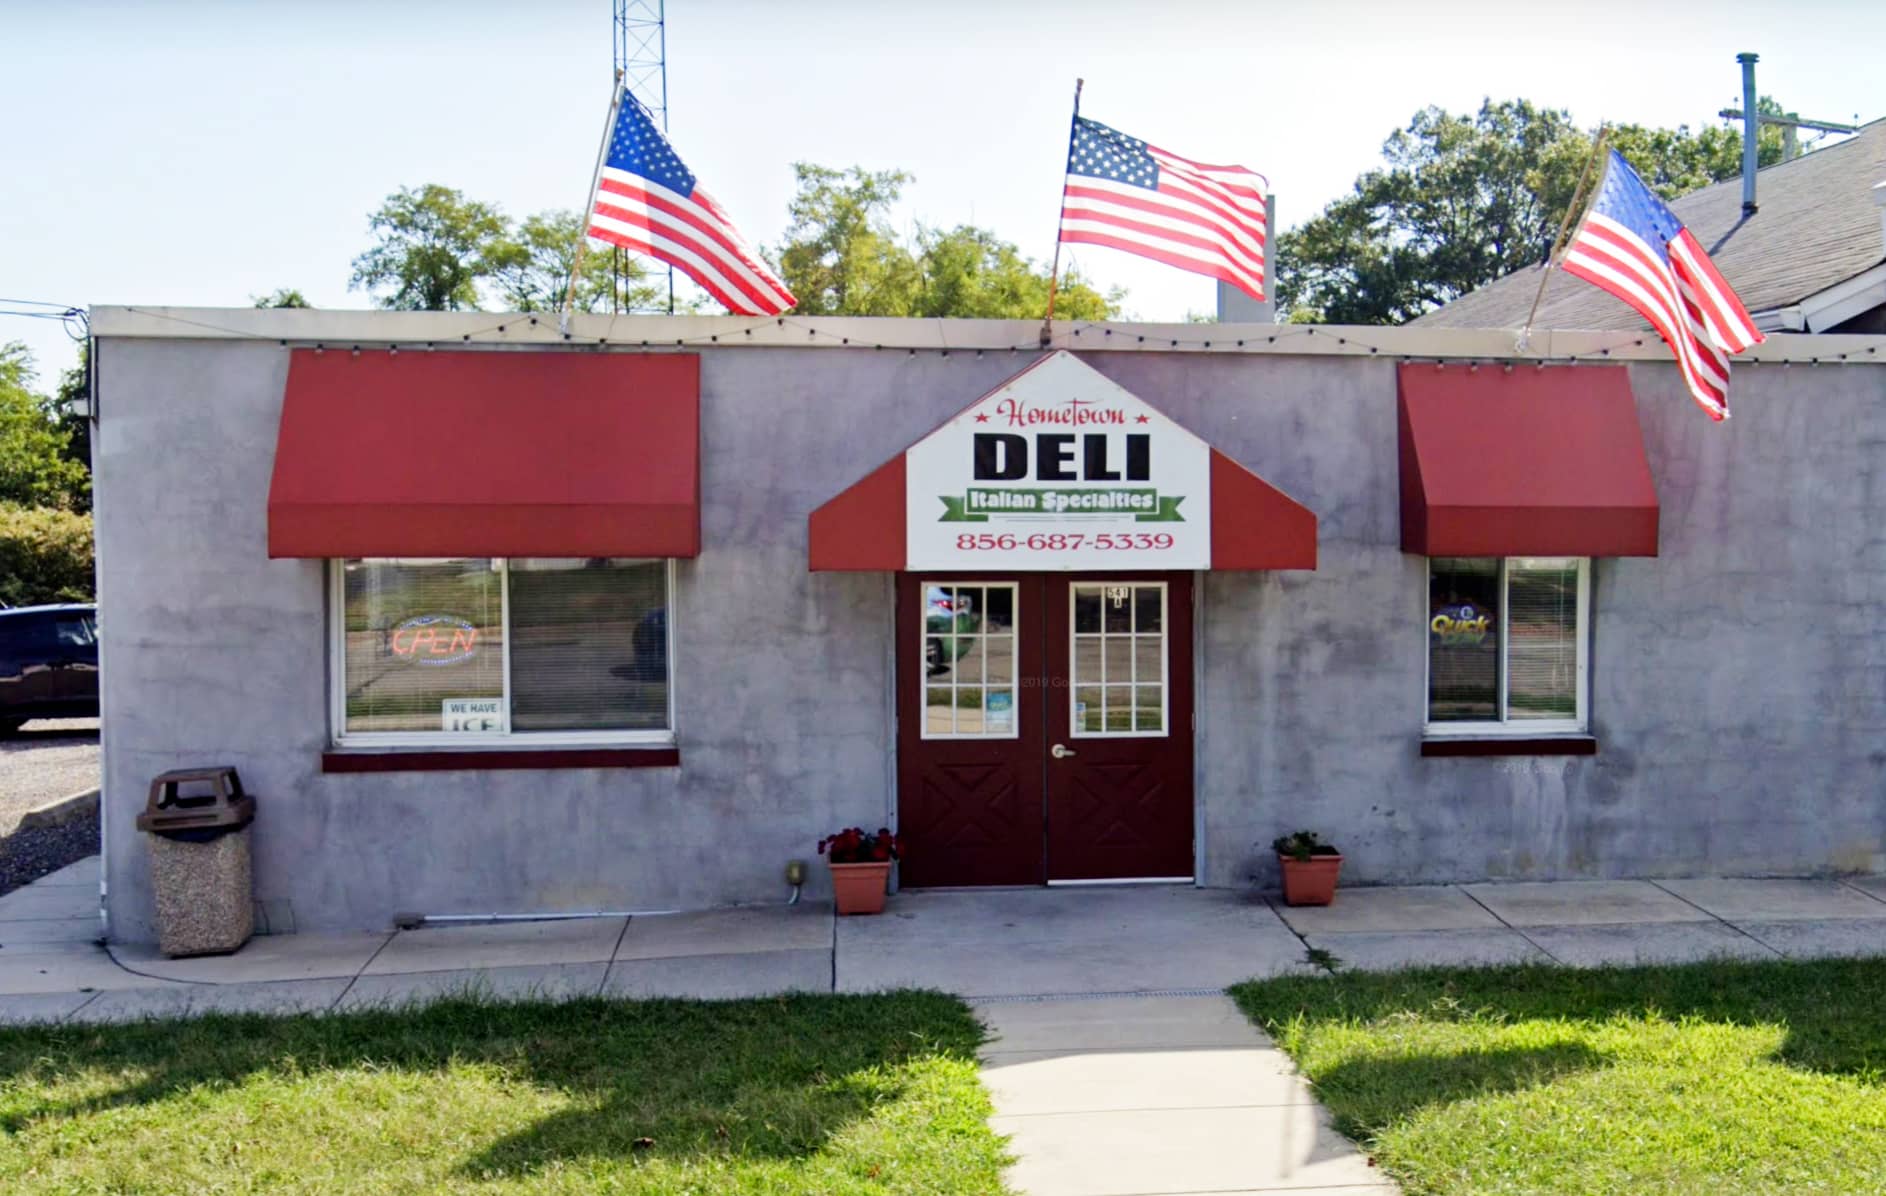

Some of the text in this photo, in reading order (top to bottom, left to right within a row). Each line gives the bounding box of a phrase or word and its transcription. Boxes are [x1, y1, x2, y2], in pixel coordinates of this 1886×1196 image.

[974, 433, 1150, 481] DELI
[970, 491, 1154, 512] Italian Specialties
[956, 533, 1175, 550] 856-687-5339
[1431, 614, 1489, 635] Quick
[391, 627, 478, 655] OPEN
[450, 703, 497, 713] WE HAVE
